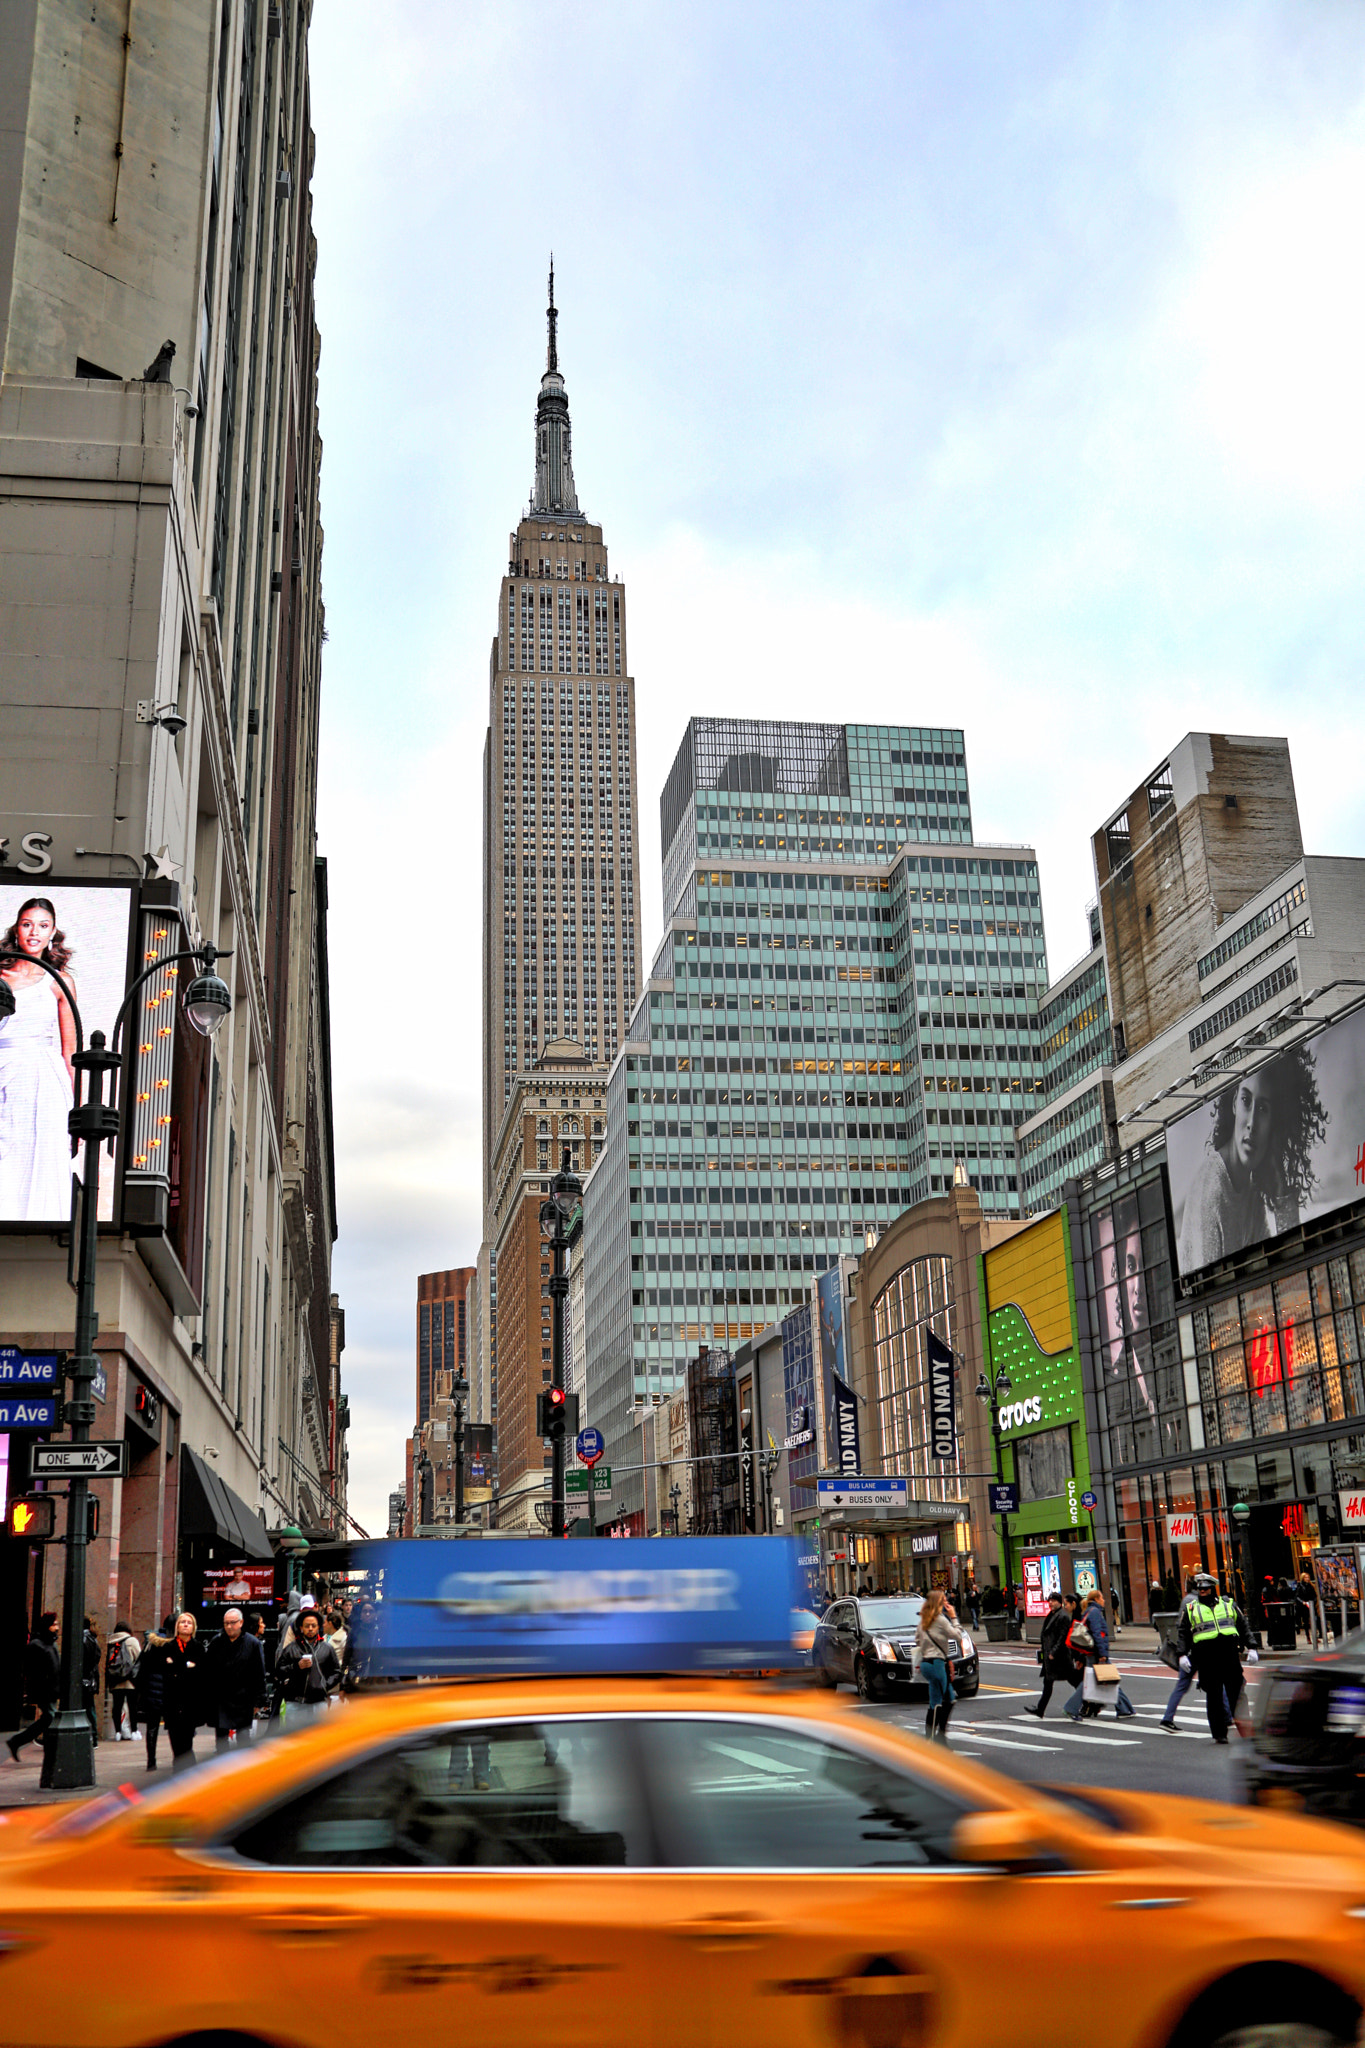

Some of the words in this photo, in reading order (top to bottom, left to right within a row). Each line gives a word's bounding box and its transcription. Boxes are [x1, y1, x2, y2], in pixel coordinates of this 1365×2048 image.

[18, 1361, 53, 1378] Ave
[932, 1359, 951, 1412] NAVY
[13, 1404, 48, 1422] Ave
[999, 1395, 1042, 1431] crocs
[839, 1401, 856, 1446] NAVY
[784, 1430, 811, 1447] SKECHERS
[935, 1416, 953, 1456] OLD
[46, 1454, 70, 1465] ONE
[82, 1453, 109, 1464] WAY
[741, 1437, 751, 1474] KAY
[848, 1482, 860, 1490] BUS
[861, 1482, 876, 1490] LANE
[849, 1495, 873, 1504] BUSES
[875, 1495, 893, 1504] ONLY
[1067, 1481, 1078, 1524] crocs
[929, 1506, 942, 1514] OLD
[943, 1507, 961, 1515] NAVY
[1171, 1518, 1193, 1537] H&M
[912, 1537, 922, 1552] OLD
[922, 1535, 937, 1551] NAVY
